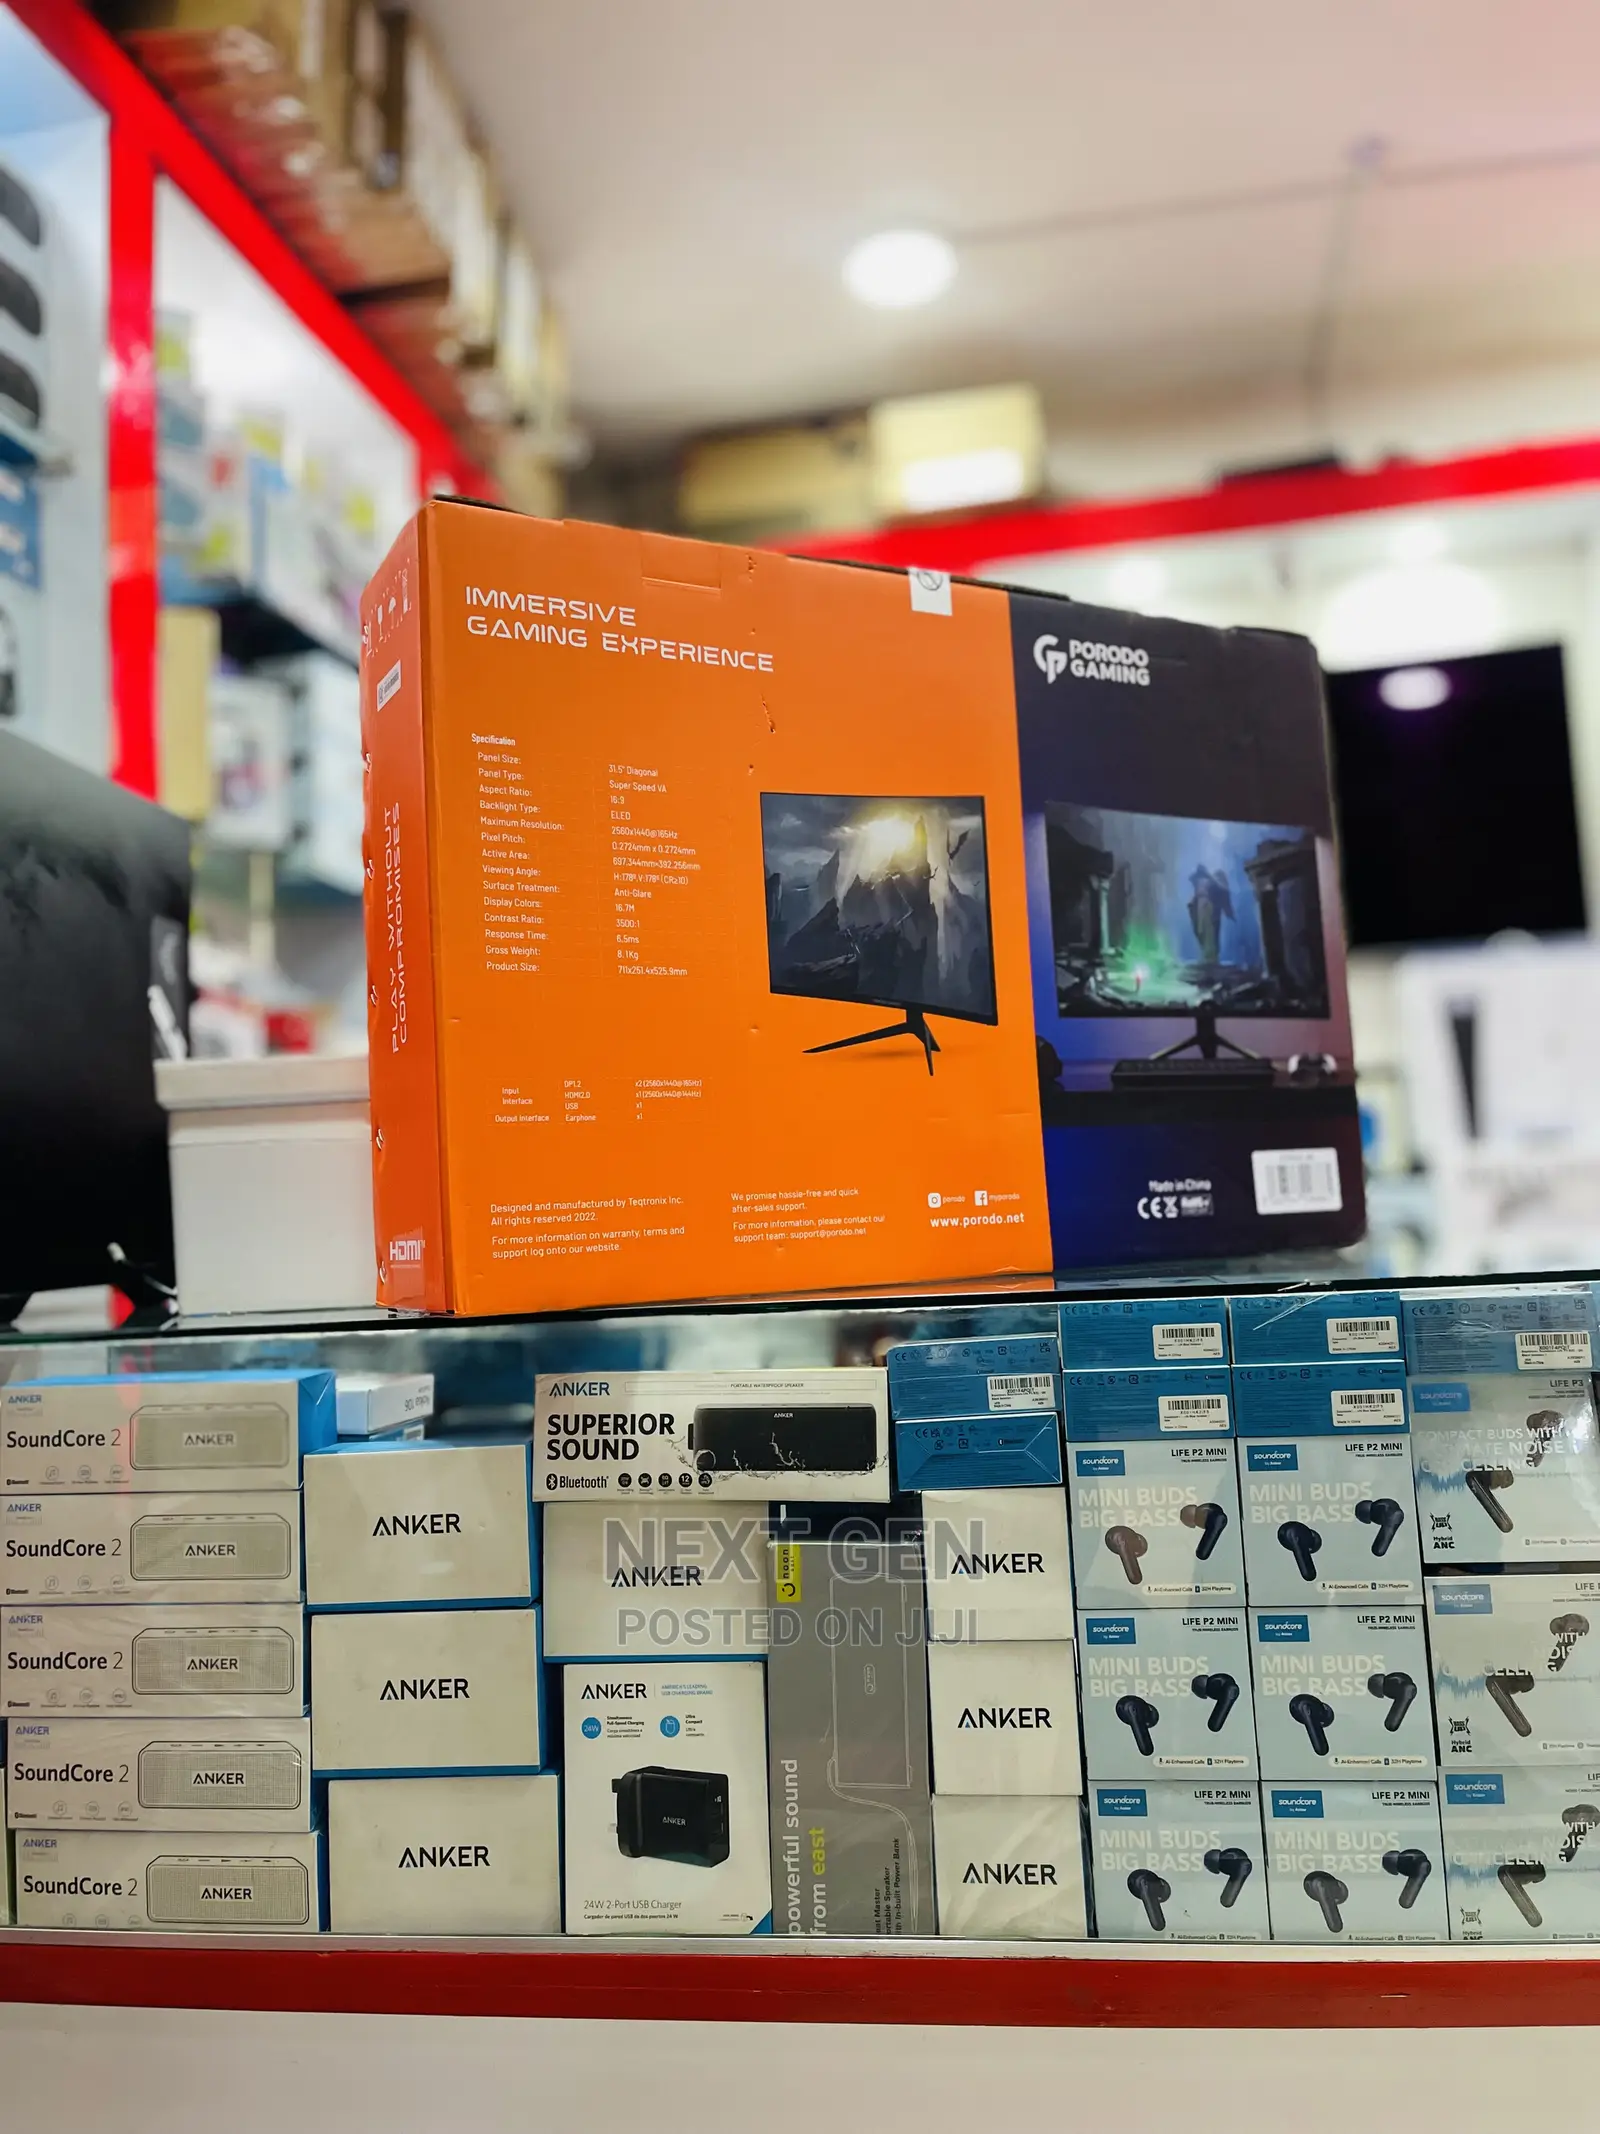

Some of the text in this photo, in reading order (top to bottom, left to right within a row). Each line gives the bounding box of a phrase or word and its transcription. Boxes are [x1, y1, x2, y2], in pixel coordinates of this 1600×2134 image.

[465, 585, 636, 627] IMMERSIVE
[467, 615, 774, 672] GAMING EXPERIENCE
[1068, 639, 1149, 667] PORODO
[1070, 659, 1151, 686] GAMING
[471, 733, 516, 746] Specification
[478, 752, 521, 764] Panel Size:
[478, 768, 524, 781] Panel Type:
[627, 766, 658, 777] Diagonal
[479, 784, 533, 797] Aspect Ratio:
[609, 779, 667, 793] Super Speed VA
[480, 800, 541, 814] Backlight Type:
[610, 795, 625, 805] 16:9
[611, 810, 631, 820] ELED
[481, 816, 565, 831] Maximum Resolution:
[481, 832, 525, 844] Pixel Pitch:
[482, 848, 530, 860] Active Area:
[482, 864, 541, 877] Viewing Angle:
[483, 880, 560, 893] Surface Treatment:
[614, 887, 652, 899] Anti-Glare
[484, 896, 543, 908] Display Colors:
[615, 904, 635, 913] 16.7M
[393, 802, 407, 1044] COMPROMISES
[484, 912, 544, 924] Contrast Ratio:
[616, 918, 640, 928] 3500:1
[384, 806, 398, 1054] PLAY WITHOUT
[485, 929, 549, 940] Response Time:
[486, 945, 541, 957] Gross Weight:
[486, 961, 540, 972] Product Size:
[566, 1114, 597, 1122] Earphone
[731, 1187, 859, 1202] We promise hassle-free and quick
[491, 1196, 684, 1214] Designed and manufactured by Teqtronix Inc.
[732, 1201, 807, 1214] after-sales support.
[491, 1212, 598, 1227] All rights reserved 2022.
[930, 1212, 1025, 1228] www.porodo.net
[492, 1236, 507, 1245] For
[510, 1236, 533, 1244] more
[535, 1231, 587, 1243] information
[643, 1227, 668, 1237] terms
[669, 1226, 685, 1235] and
[389, 1240, 421, 1261] HDMI
[492, 1248, 528, 1260] support
[530, 1246, 544, 1258] log
[546, 1245, 567, 1255] onto
[569, 1245, 583, 1254] our
[549, 1382, 610, 1399] ANKER
[1550, 1379, 1584, 1388] LIFE P3
[547, 1412, 675, 1436] SUPERIOR
[6, 1428, 122, 1448] SoundCore 2
[183, 1434, 234, 1446] ANKER
[546, 1438, 640, 1461] SOUND
[1171, 1448, 1227, 1458] LIFE P2 MINI
[1253, 1451, 1291, 1461] soundcore
[1082, 1455, 1119, 1466] soundcore
[559, 1474, 609, 1489] Bluetooth
[1078, 1485, 1197, 1507] MINI BUDS
[372, 1513, 462, 1537] ANKER
[1080, 1508, 1181, 1529] BIG BASS
[5, 1538, 122, 1558] SoundCore 2
[185, 1545, 236, 1557] ANKER
[950, 1552, 1045, 1575] ANKER
[611, 1565, 702, 1587] ANKER
[1181, 1616, 1239, 1627] LIFE P2 MINI
[1264, 1621, 1303, 1631] soundcore
[1356, 1614, 1416, 1624] LIFE P2 MINI
[1092, 1624, 1130, 1633] soundcore
[379, 1678, 470, 1701] ANKER
[581, 1683, 647, 1700] ANKER
[957, 1707, 1052, 1729] ANKER
[584, 1725, 599, 1733] 24W
[14, 1763, 130, 1783] SoundCore 2
[192, 1772, 244, 1785] ANKER
[1453, 1781, 1497, 1791] soundcore
[1278, 1796, 1317, 1807] soundcore
[662, 1816, 686, 1826] ANKER
[781, 1758, 806, 1934] powerful sound
[398, 1845, 491, 1868] ANKER
[808, 1827, 827, 1934] from east
[962, 1862, 1058, 1885] ANKER
[23, 1875, 138, 1896] SoundCore 2
[884, 1866, 892, 1902] Speaker
[201, 1887, 252, 1901] ANKER
[584, 1900, 682, 1911] 24W 2-Port USB Charger
